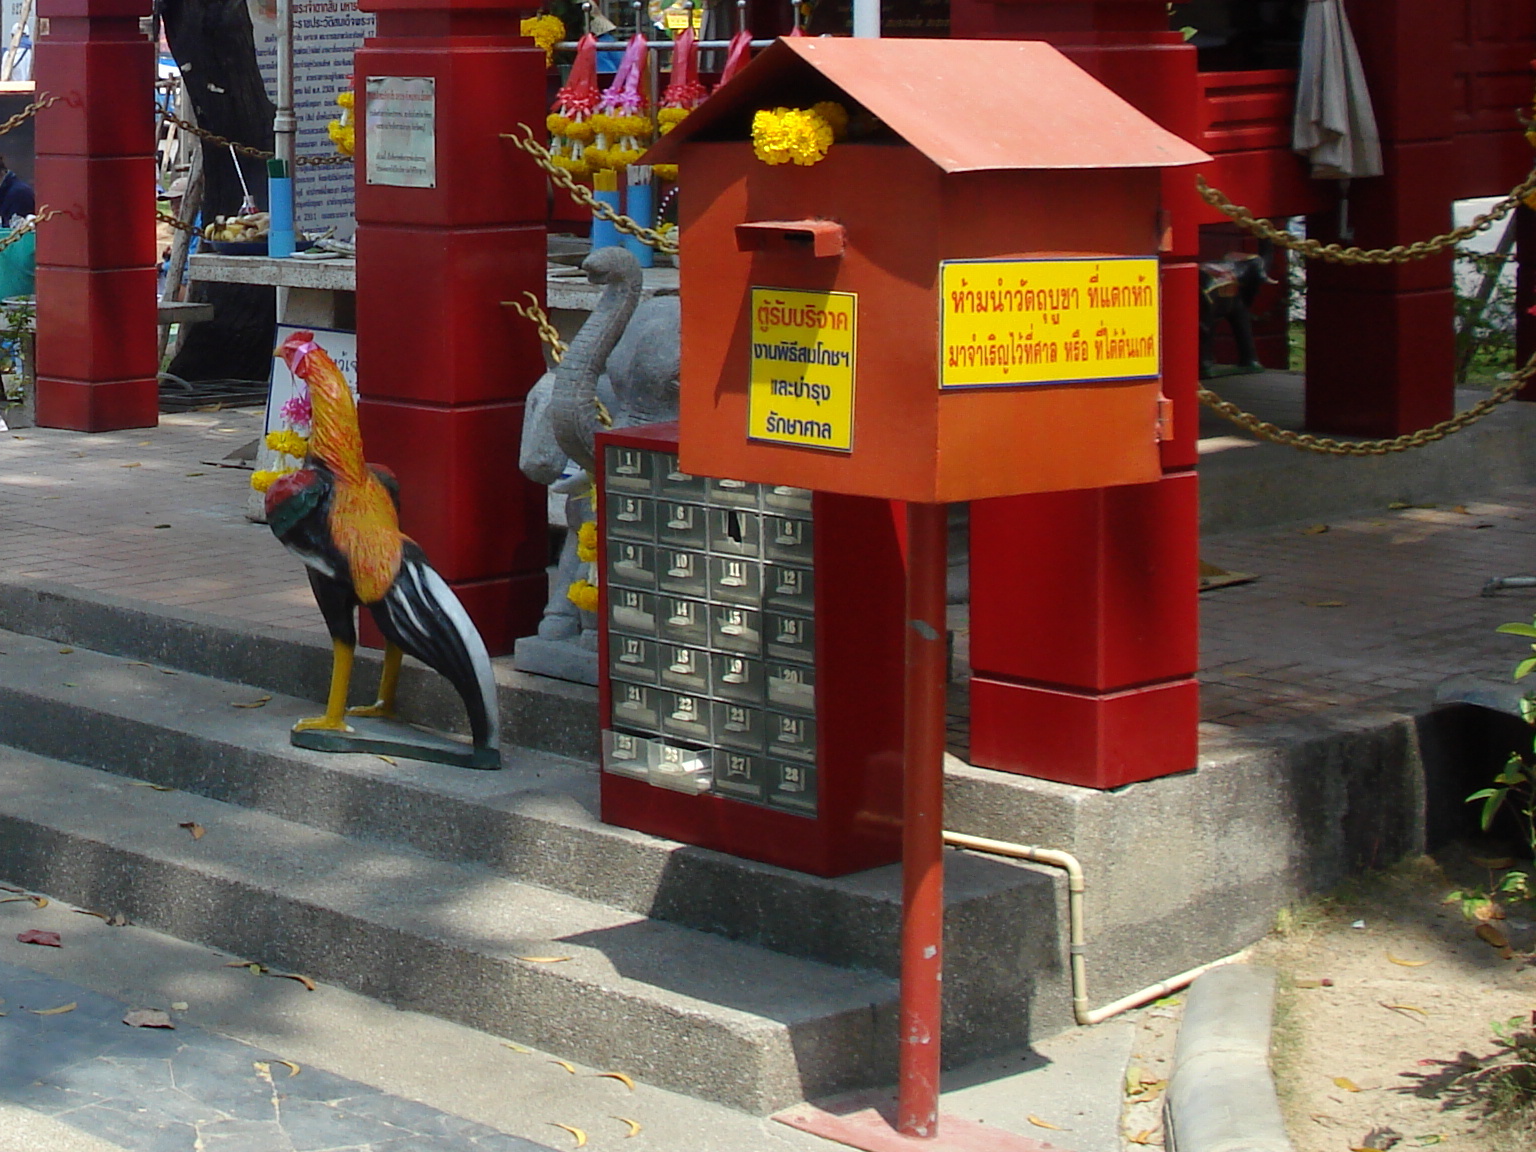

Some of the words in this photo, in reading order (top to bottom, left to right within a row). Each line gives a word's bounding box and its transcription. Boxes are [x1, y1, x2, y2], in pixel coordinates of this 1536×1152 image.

[1087, 264, 1153, 308] ที่แตกหัก
[757, 299, 849, 333] ตู้รับบริจาค
[1064, 329, 1089, 362] หรือ
[770, 376, 831, 406] และบำรุง
[766, 411, 832, 439] รักษาศาล
[626, 452, 631, 465] 1
[627, 500, 633, 512] 5
[677, 506, 684, 519] 6
[785, 522, 792, 534] 8
[627, 546, 634, 559] 9
[676, 554, 687, 567] 10
[729, 563, 740, 577] 11
[784, 571, 795, 584] 12
[627, 593, 637, 606] 13
[676, 602, 687, 616] 14
[729, 610, 741, 624] 15
[628, 640, 638, 653] 17
[677, 650, 688, 663] 18
[731, 659, 742, 673] 19
[629, 687, 640, 700] 21
[679, 698, 692, 711] 22
[784, 719, 796, 733] 24
[731, 757, 744, 770] 27
